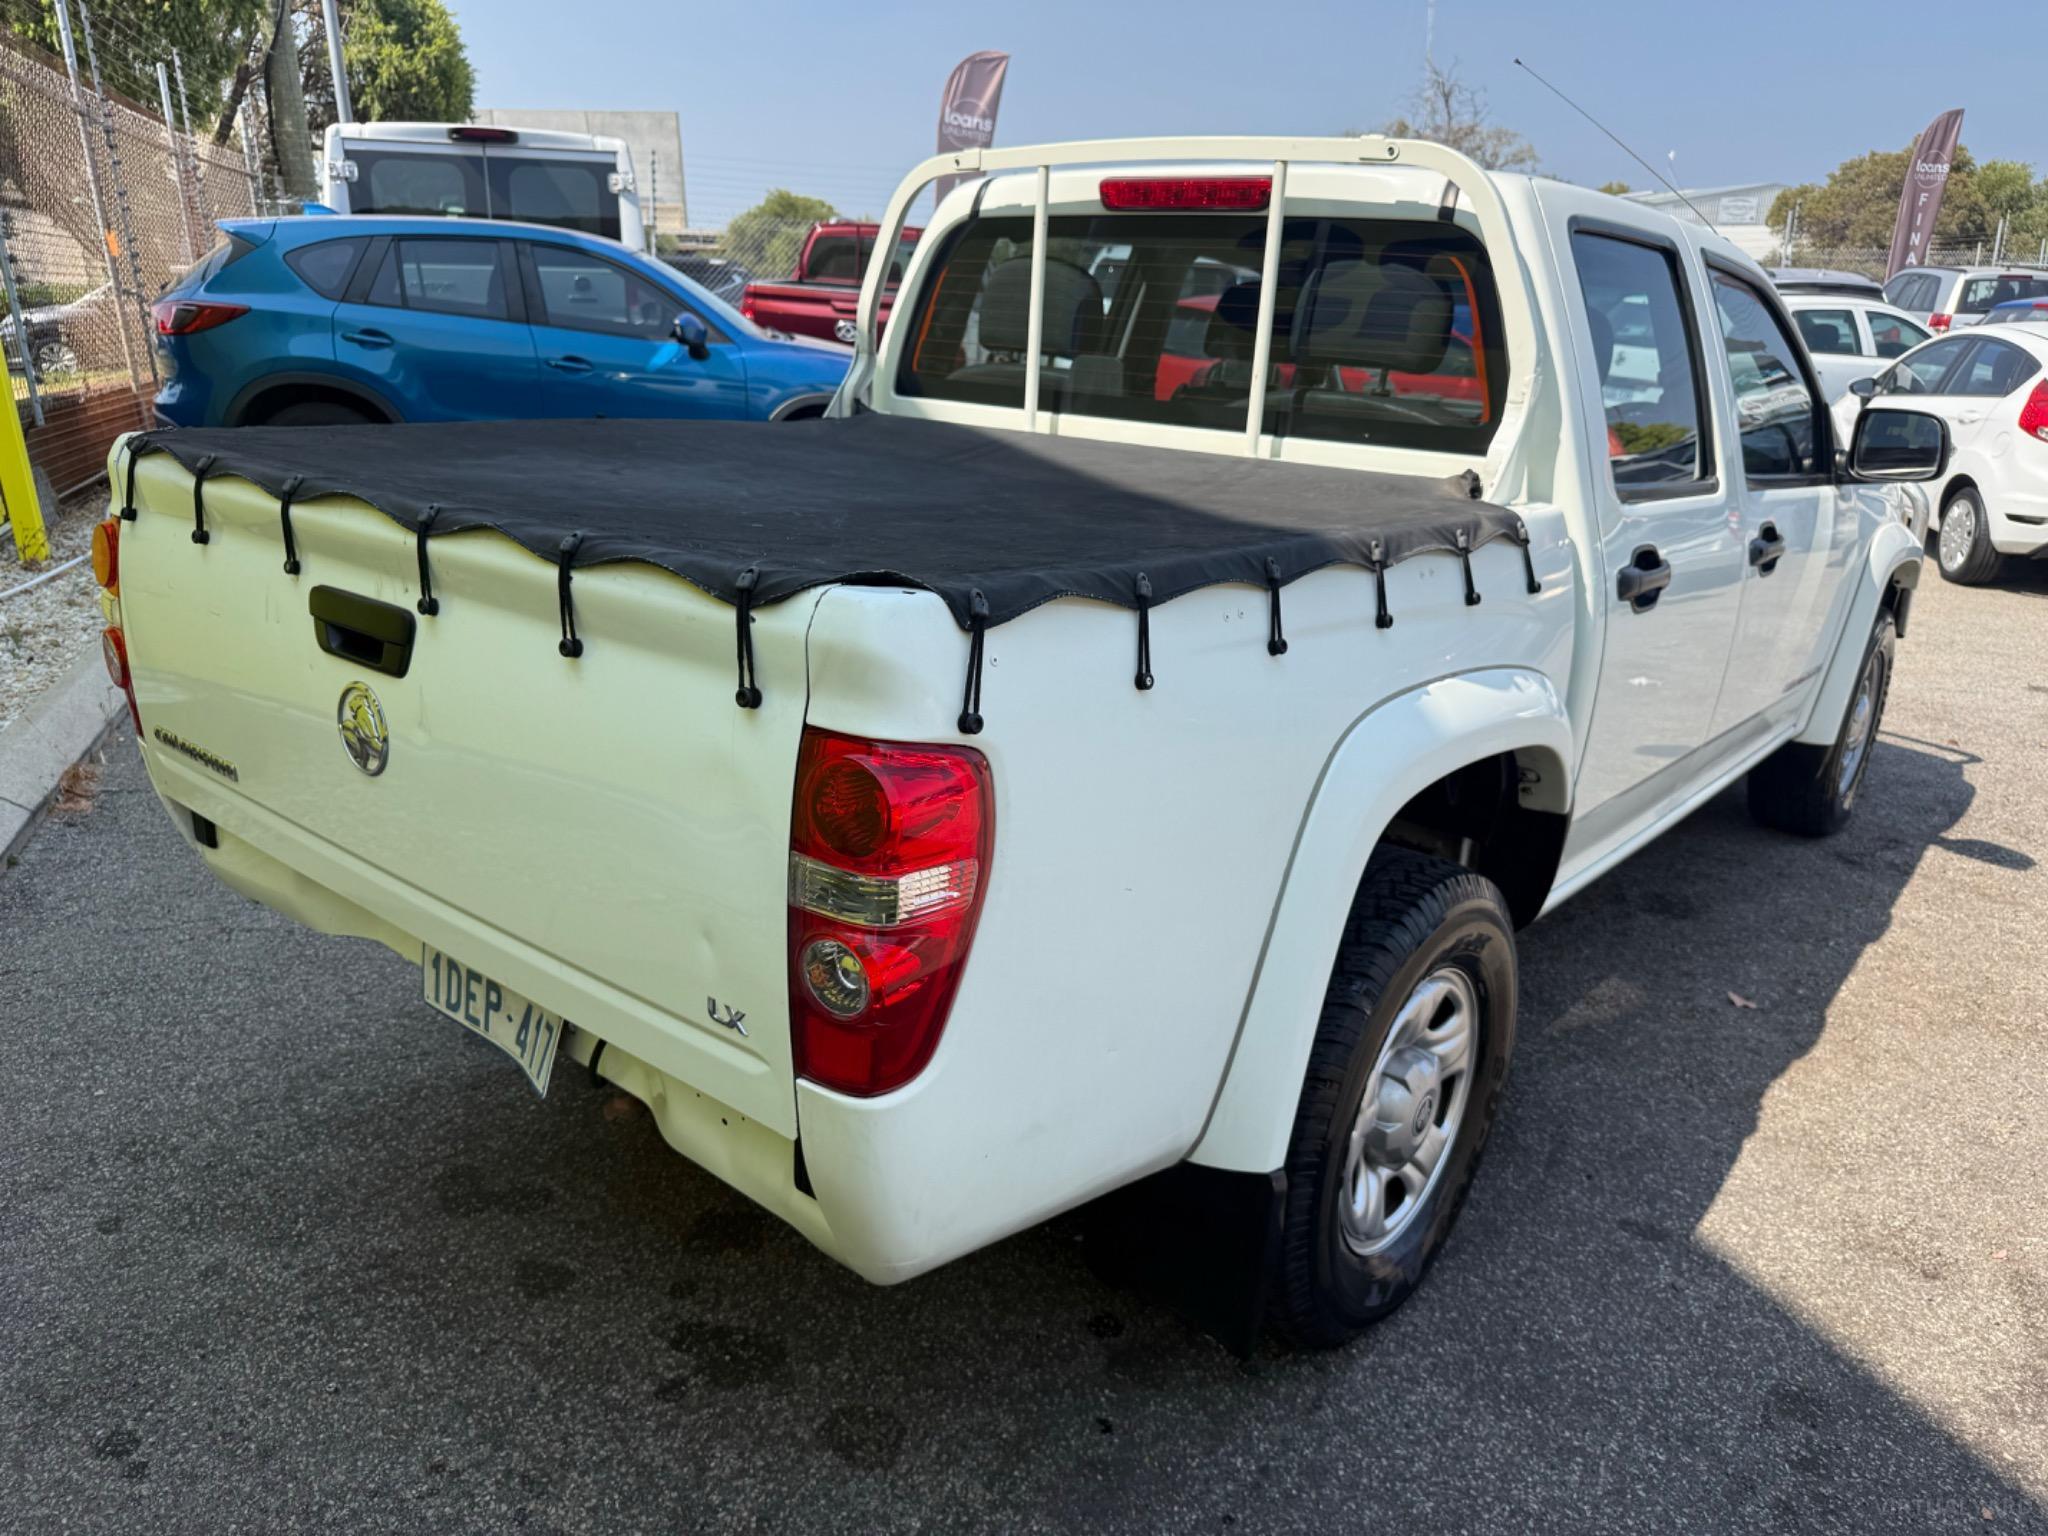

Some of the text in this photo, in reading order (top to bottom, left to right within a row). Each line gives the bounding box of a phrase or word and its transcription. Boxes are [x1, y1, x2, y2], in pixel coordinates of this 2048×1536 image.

[944, 106, 993, 132] loans
[1916, 159, 1950, 174] loans
[707, 996, 749, 1037] LX
